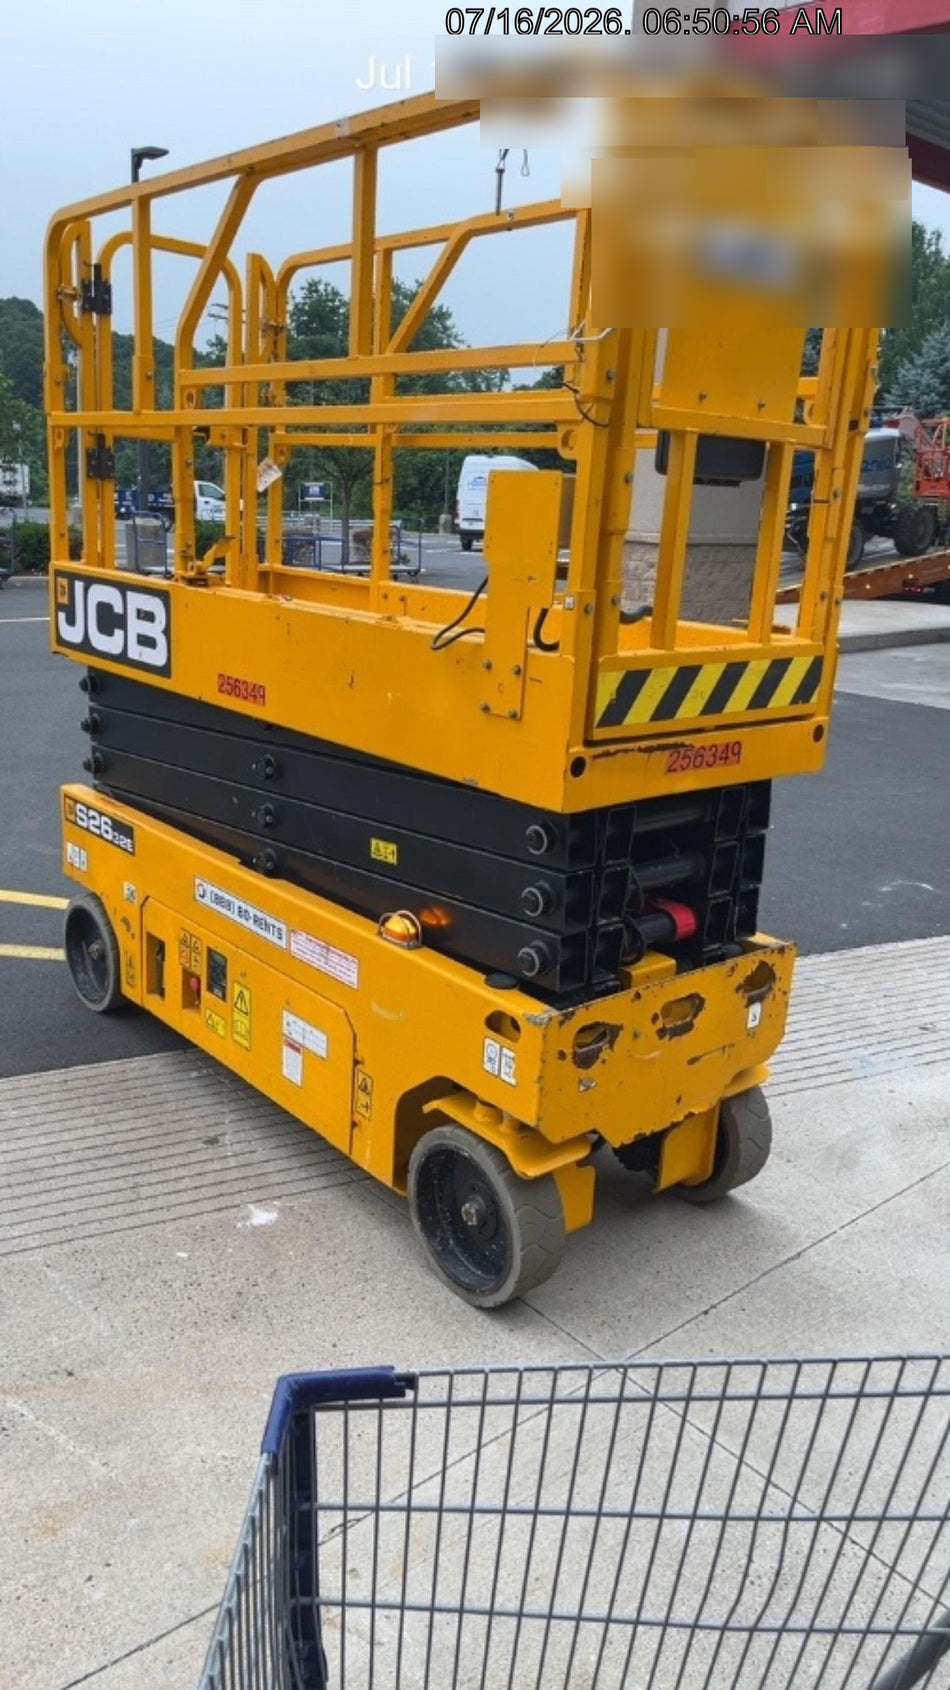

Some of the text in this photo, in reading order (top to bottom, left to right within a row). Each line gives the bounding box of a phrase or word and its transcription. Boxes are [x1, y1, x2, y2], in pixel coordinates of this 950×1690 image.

[58, 580, 168, 667] JCB
[217, 673, 266, 706] 256349
[665, 741, 742, 773] 256349
